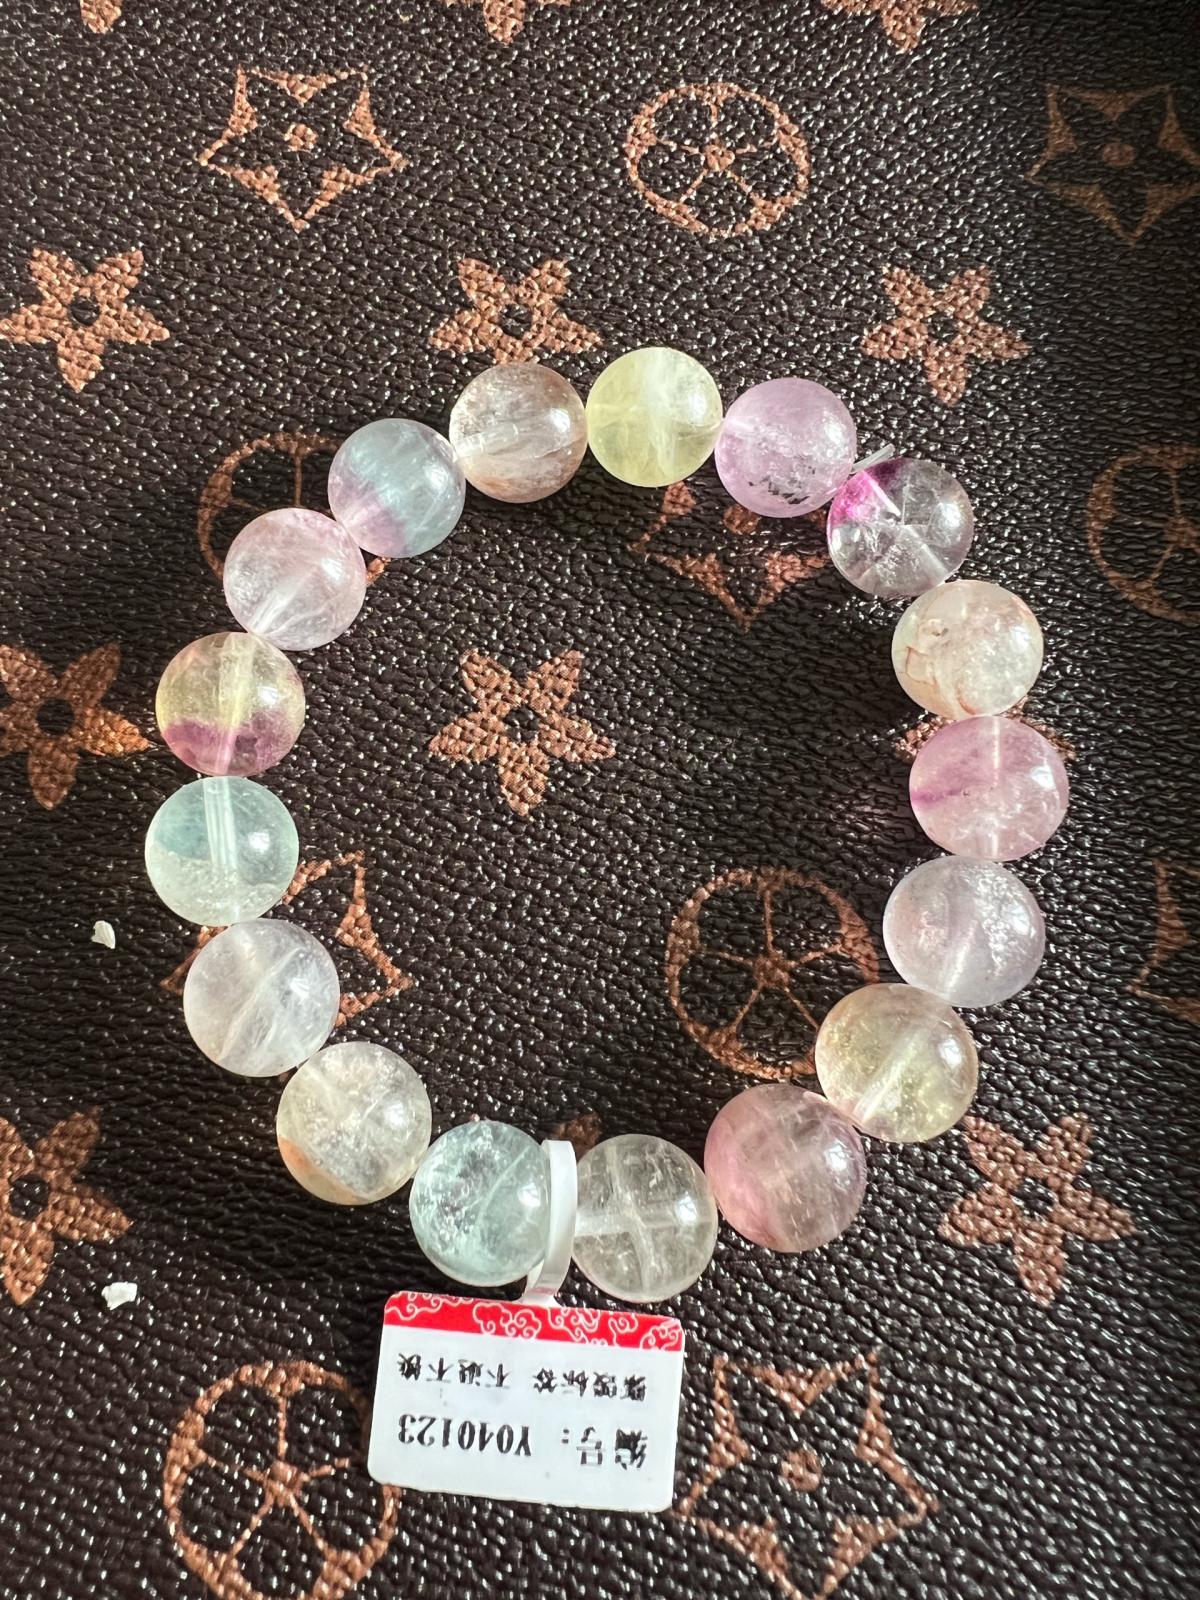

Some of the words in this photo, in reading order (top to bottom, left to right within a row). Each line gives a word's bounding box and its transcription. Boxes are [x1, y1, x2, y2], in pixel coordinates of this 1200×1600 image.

[398, 1353, 510, 1389] 不退不换
[398, 1413, 532, 1456] Y040123
